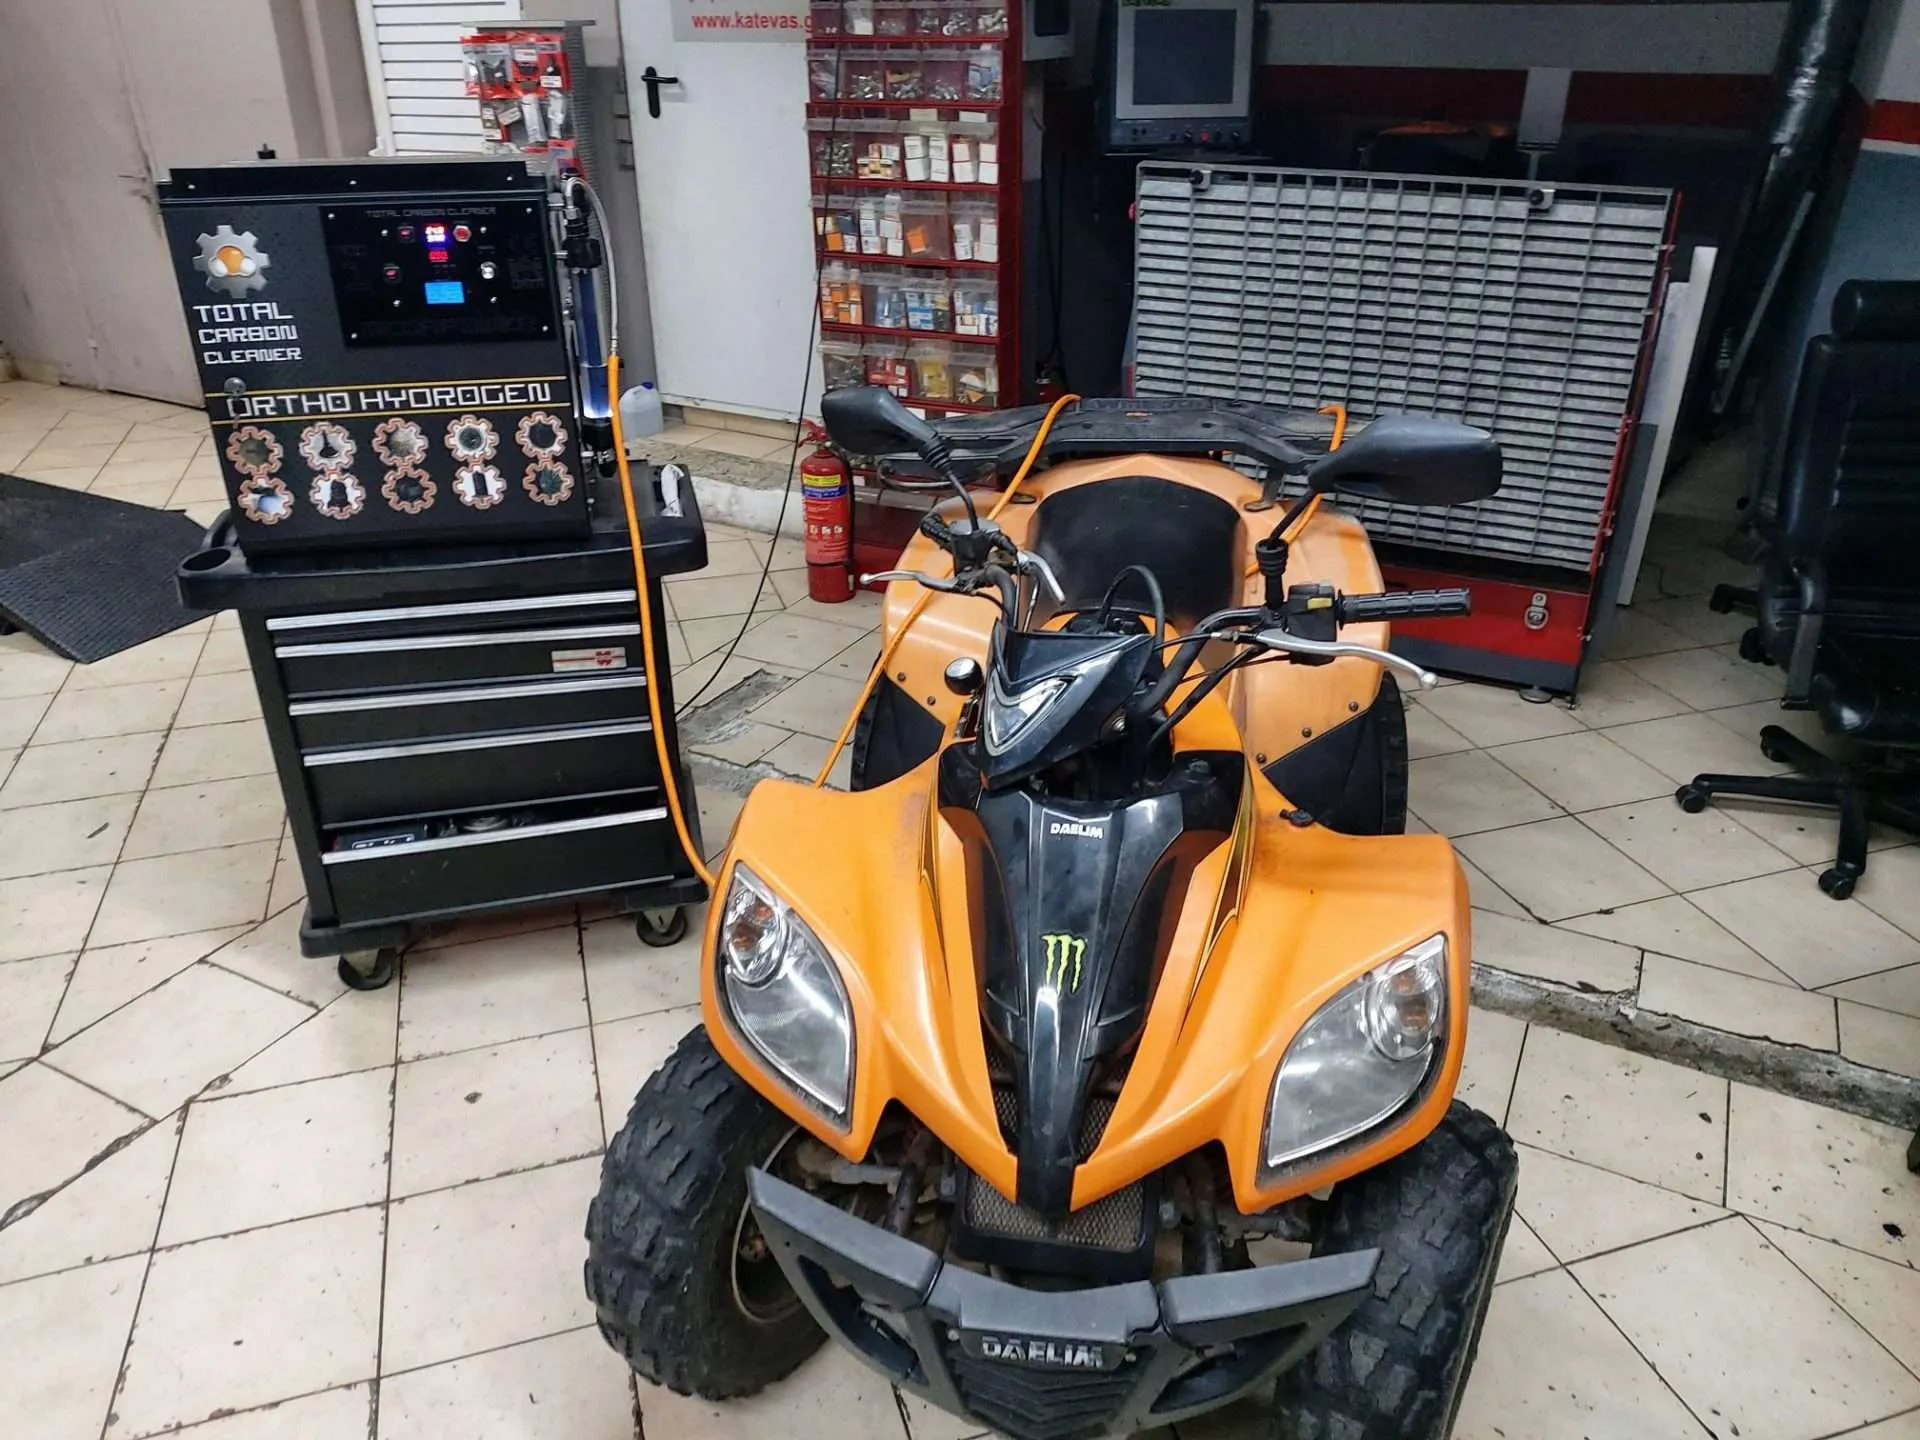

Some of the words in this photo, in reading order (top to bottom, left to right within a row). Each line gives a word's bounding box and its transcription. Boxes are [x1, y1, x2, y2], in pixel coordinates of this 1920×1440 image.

[192, 302, 294, 323] TOTAL
[198, 325, 298, 344] CARBON
[203, 347, 303, 365] CLEANER
[226, 392, 351, 418] ORTHO
[359, 383, 551, 411] HYDROGEN
[1050, 823, 1103, 839] DAELIM
[982, 1336, 1103, 1368] DAELIM
